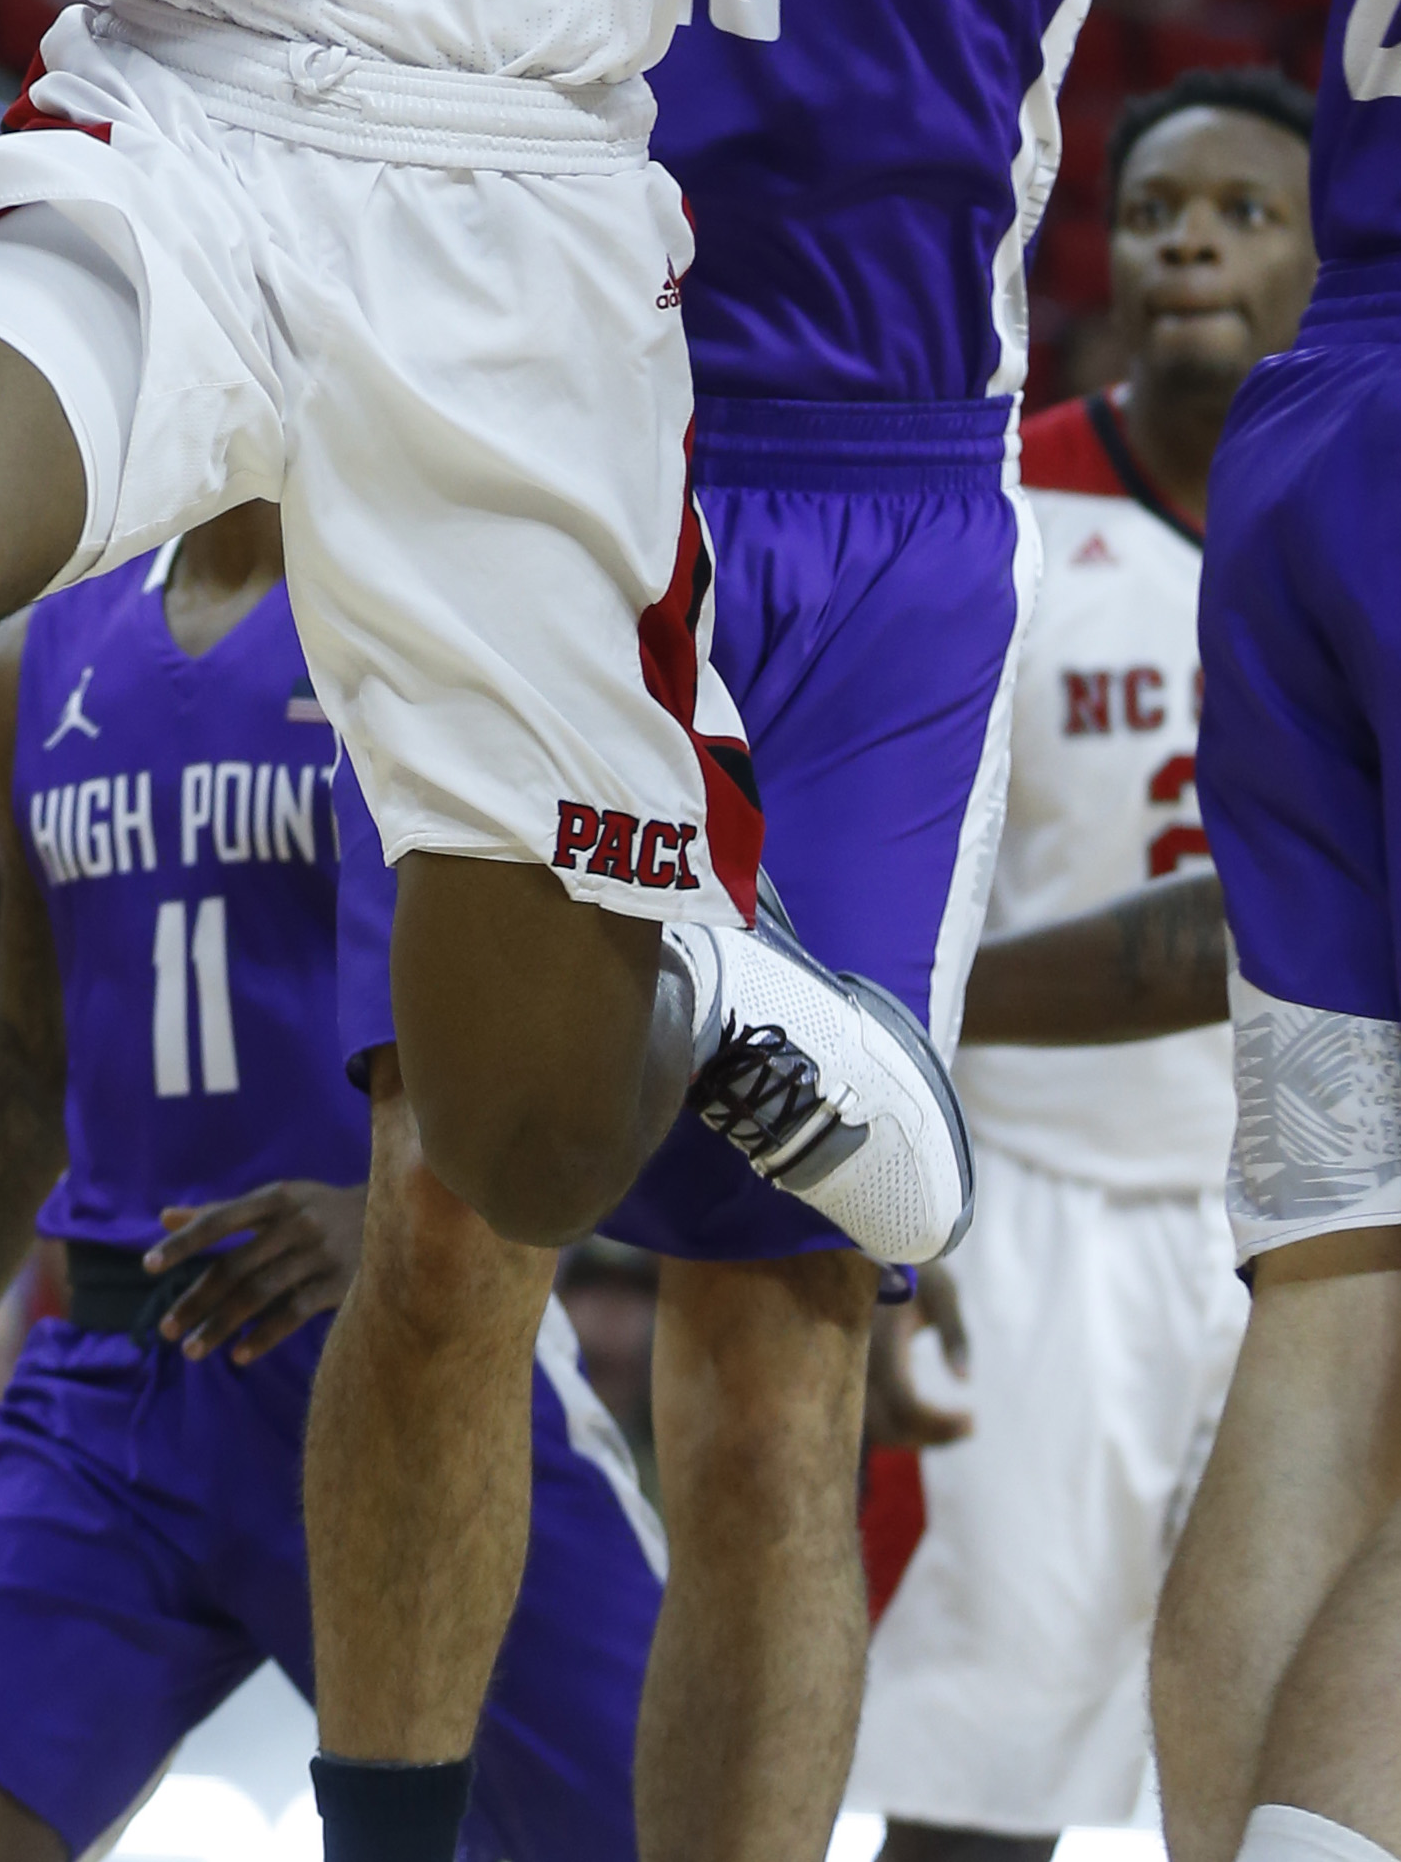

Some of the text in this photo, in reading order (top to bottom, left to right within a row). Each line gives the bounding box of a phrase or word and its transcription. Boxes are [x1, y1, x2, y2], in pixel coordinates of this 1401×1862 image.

[1062, 666, 1167, 739] NC
[30, 760, 340, 886] HIGH POIN
[153, 895, 240, 1098] 11
